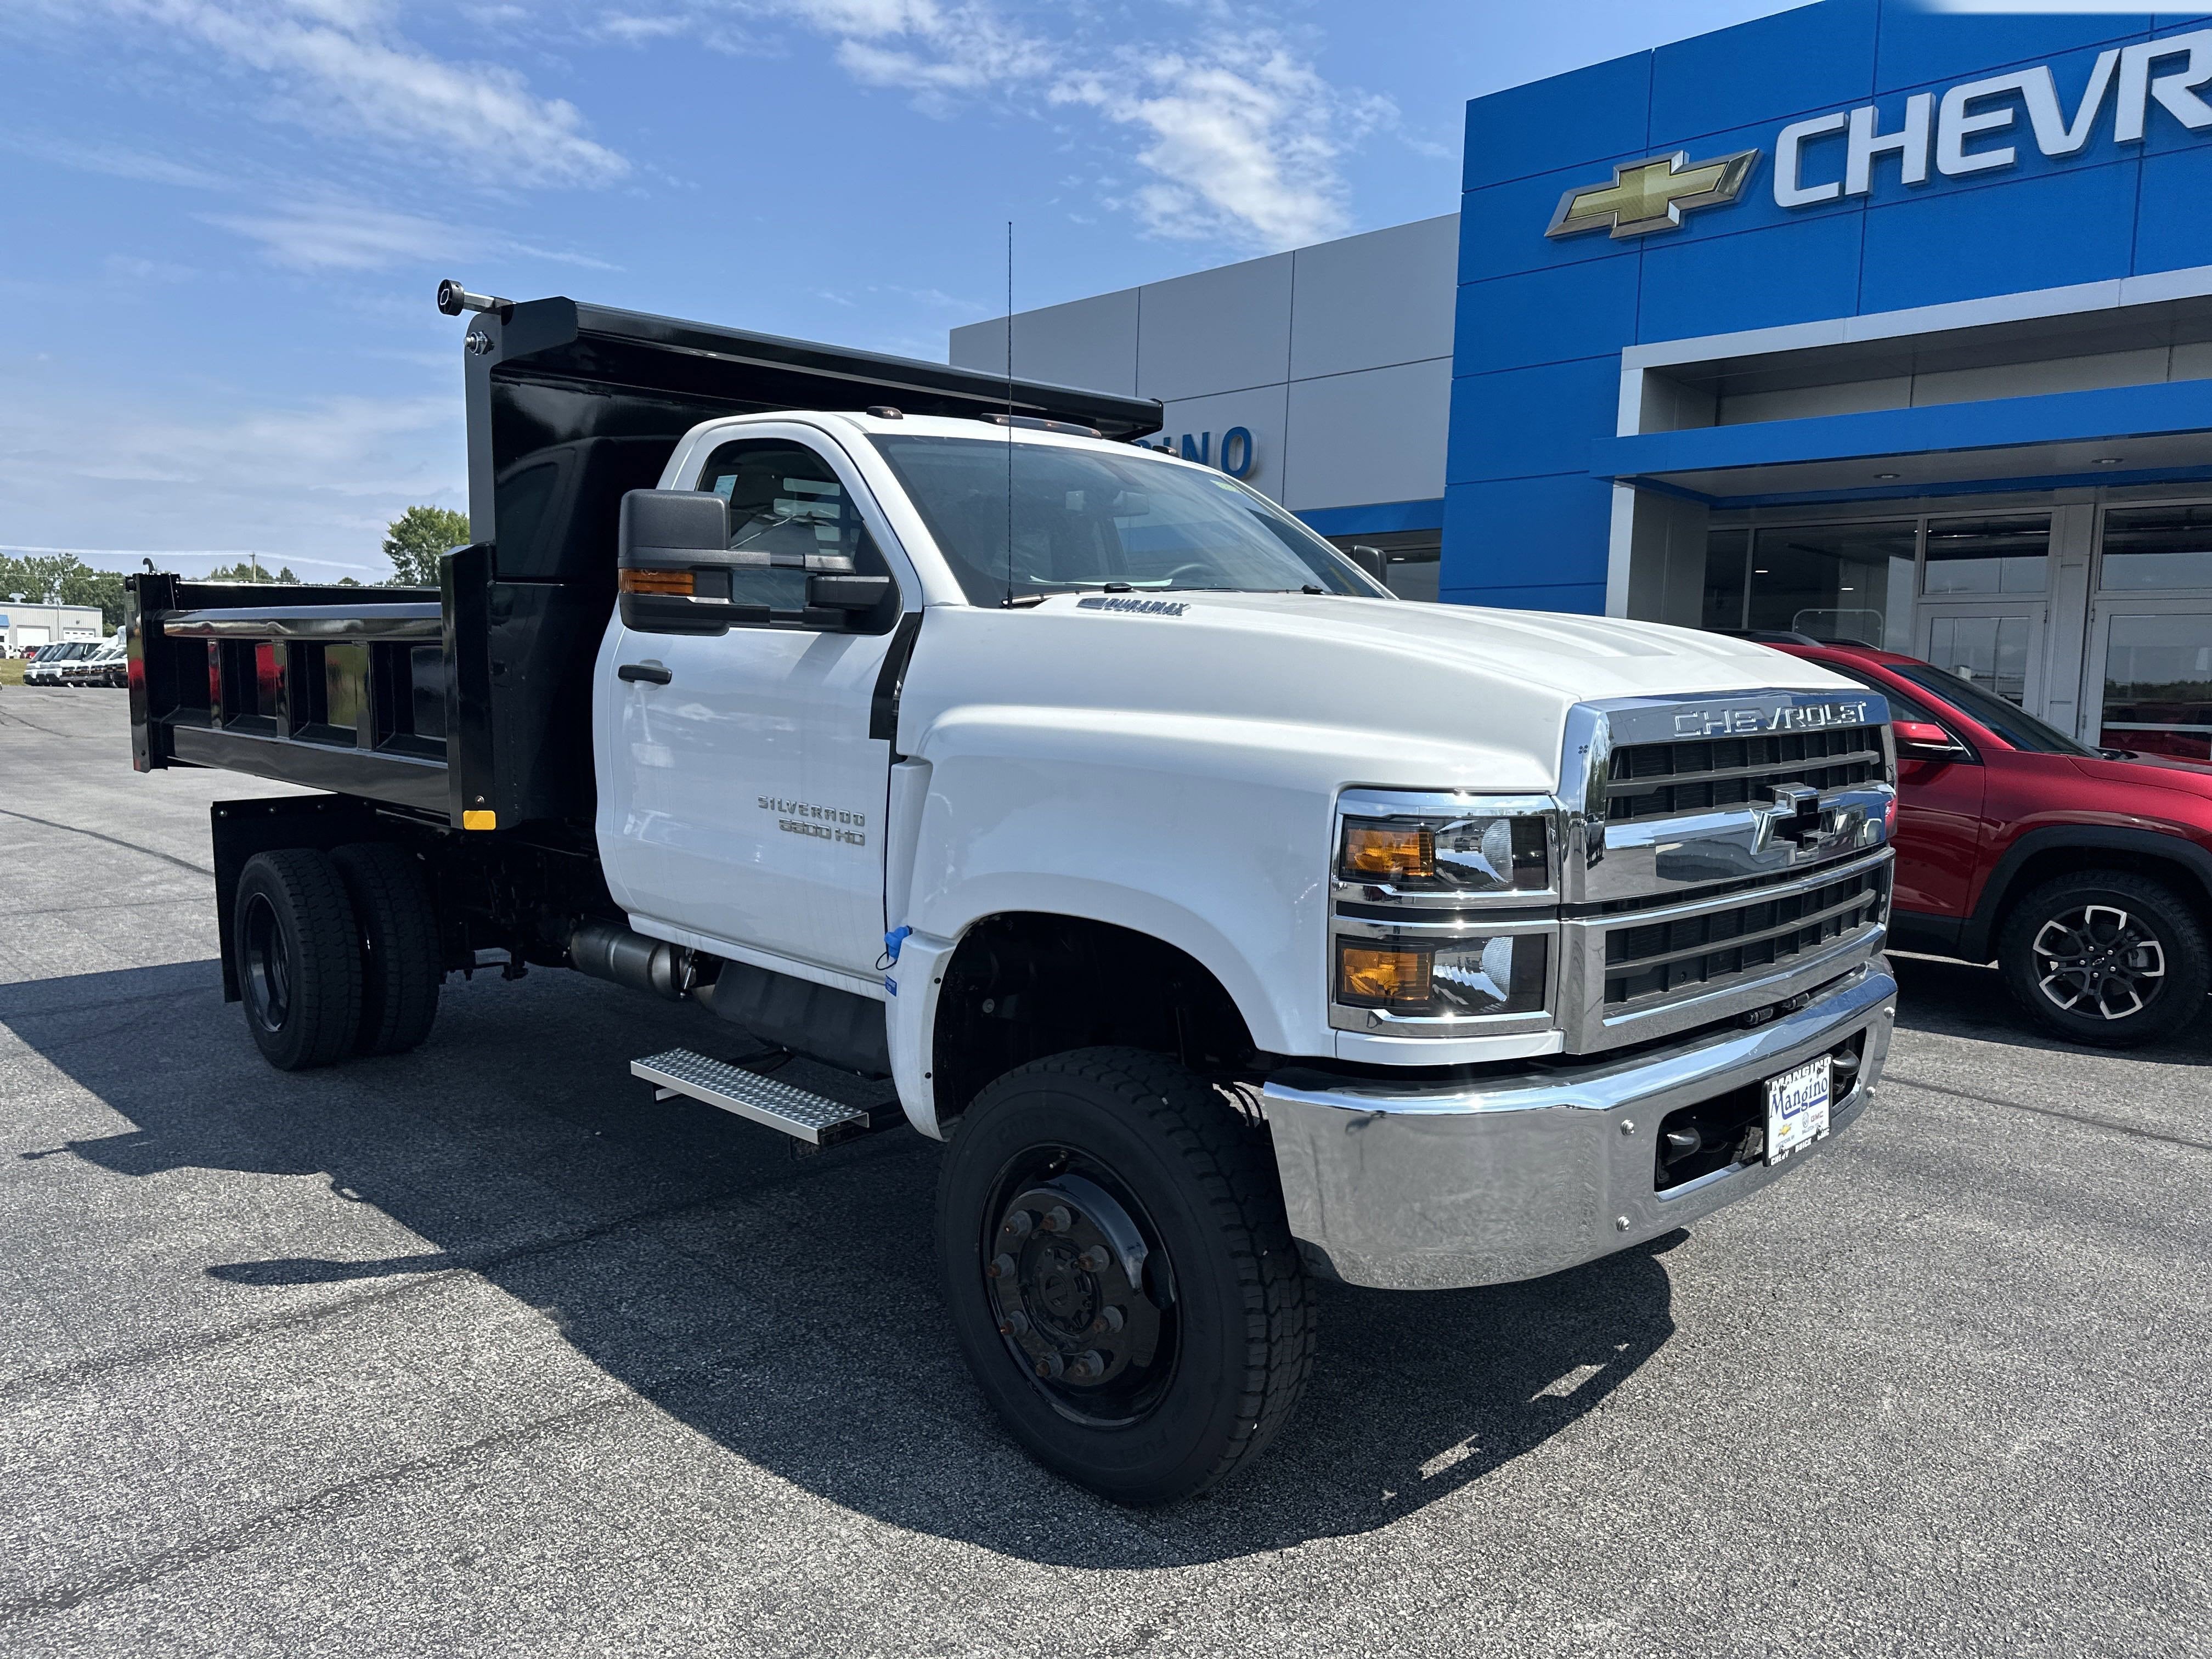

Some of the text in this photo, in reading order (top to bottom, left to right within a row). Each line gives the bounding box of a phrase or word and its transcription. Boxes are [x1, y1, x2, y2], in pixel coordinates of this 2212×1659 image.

[1774, 29, 2212, 208] CHEVR
[1103, 598, 1191, 616] DURAMAX
[1674, 701, 1867, 737] CHEVROLET
[758, 795, 865, 826] SILVERADO
[835, 828, 865, 845] HD
[1771, 1056, 1831, 1092] MANGINO
[1769, 1077, 1828, 1120] Mangino
[1810, 1110, 1824, 1122] GMC
[1795, 1137, 1812, 1153] BUICK
